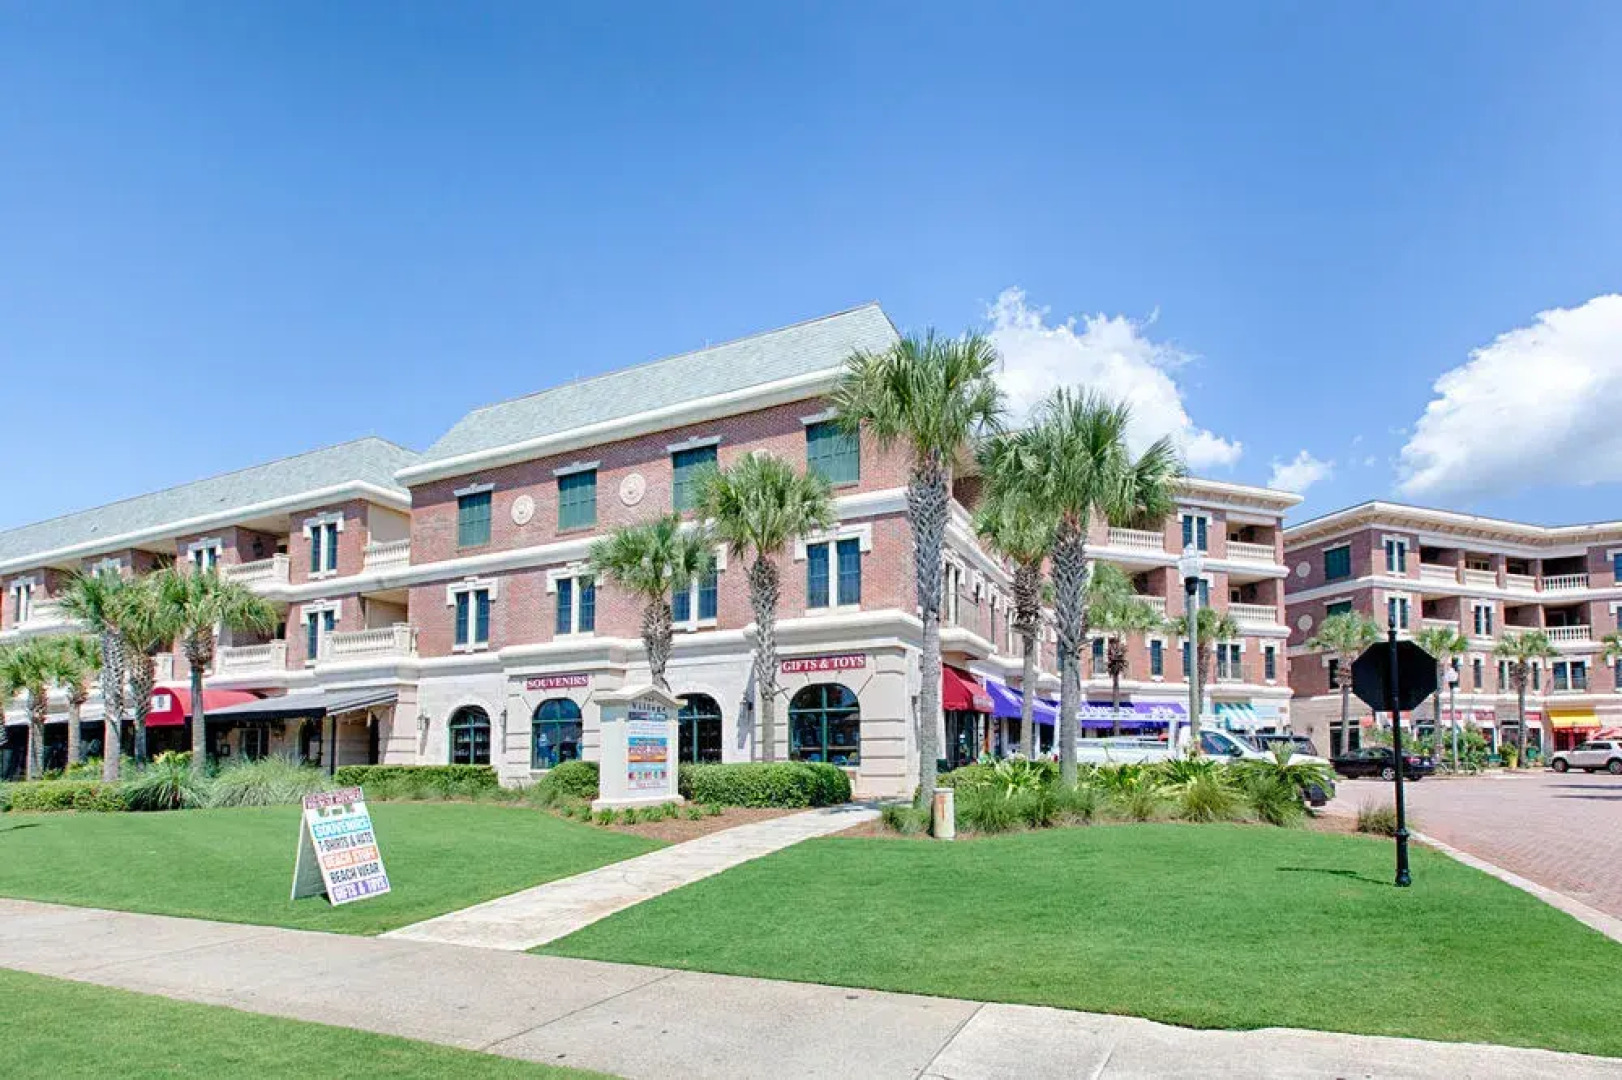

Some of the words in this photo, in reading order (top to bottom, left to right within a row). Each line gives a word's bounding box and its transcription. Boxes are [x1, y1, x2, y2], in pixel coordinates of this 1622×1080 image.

[782, 660, 817, 671] GIFTS
[819, 659, 829, 669] &
[833, 656, 864, 668] TOYS
[528, 676, 587, 688] SOUVENIRS
[317, 837, 349, 852] T-SHIRTS
[330, 867, 358, 884] BEACH
[357, 863, 379, 877] WEAR
